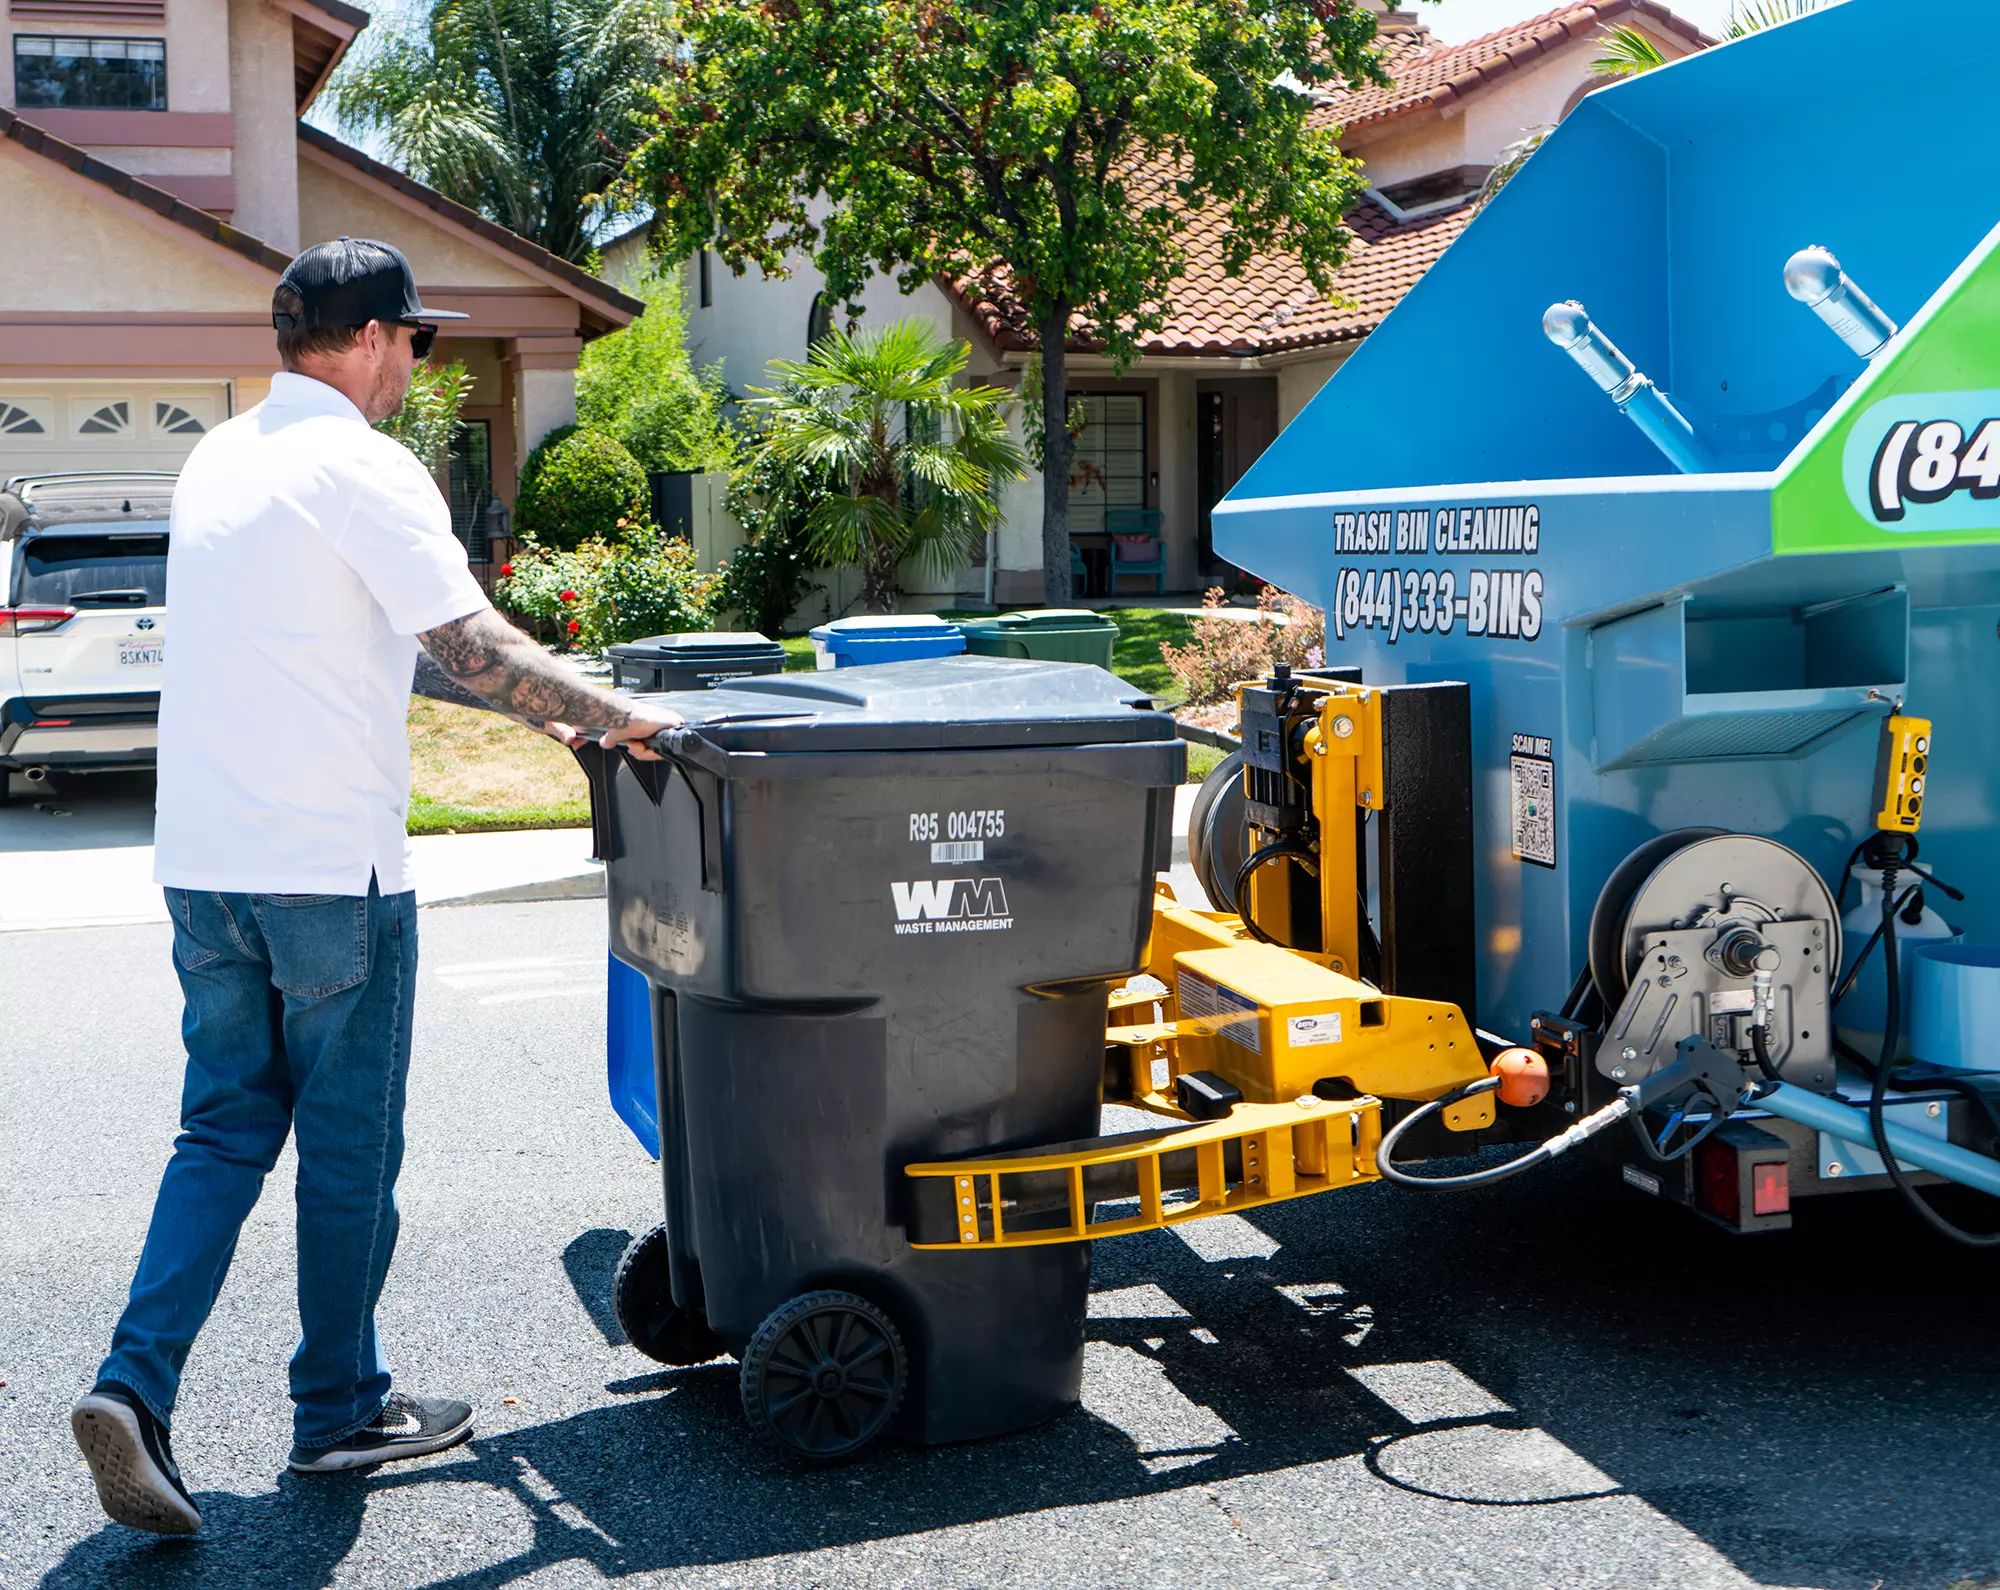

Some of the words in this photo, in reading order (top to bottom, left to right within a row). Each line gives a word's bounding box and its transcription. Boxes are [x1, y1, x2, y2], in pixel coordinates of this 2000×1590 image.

[1334, 510, 1392, 555] TRASH
[1395, 508, 1431, 555] BIN
[1434, 504, 1540, 555] CLEANING
[1334, 567, 1544, 645] (844)333-BINS
[1511, 733, 1535, 756] SCAN
[1535, 737, 1552, 758] ME!
[909, 812, 939, 841] R95
[947, 809, 1005, 840] 004755
[890, 877, 1009, 921] WM
[894, 922, 933, 935] WASTE
[935, 918, 1014, 933] MANAGEMENT
